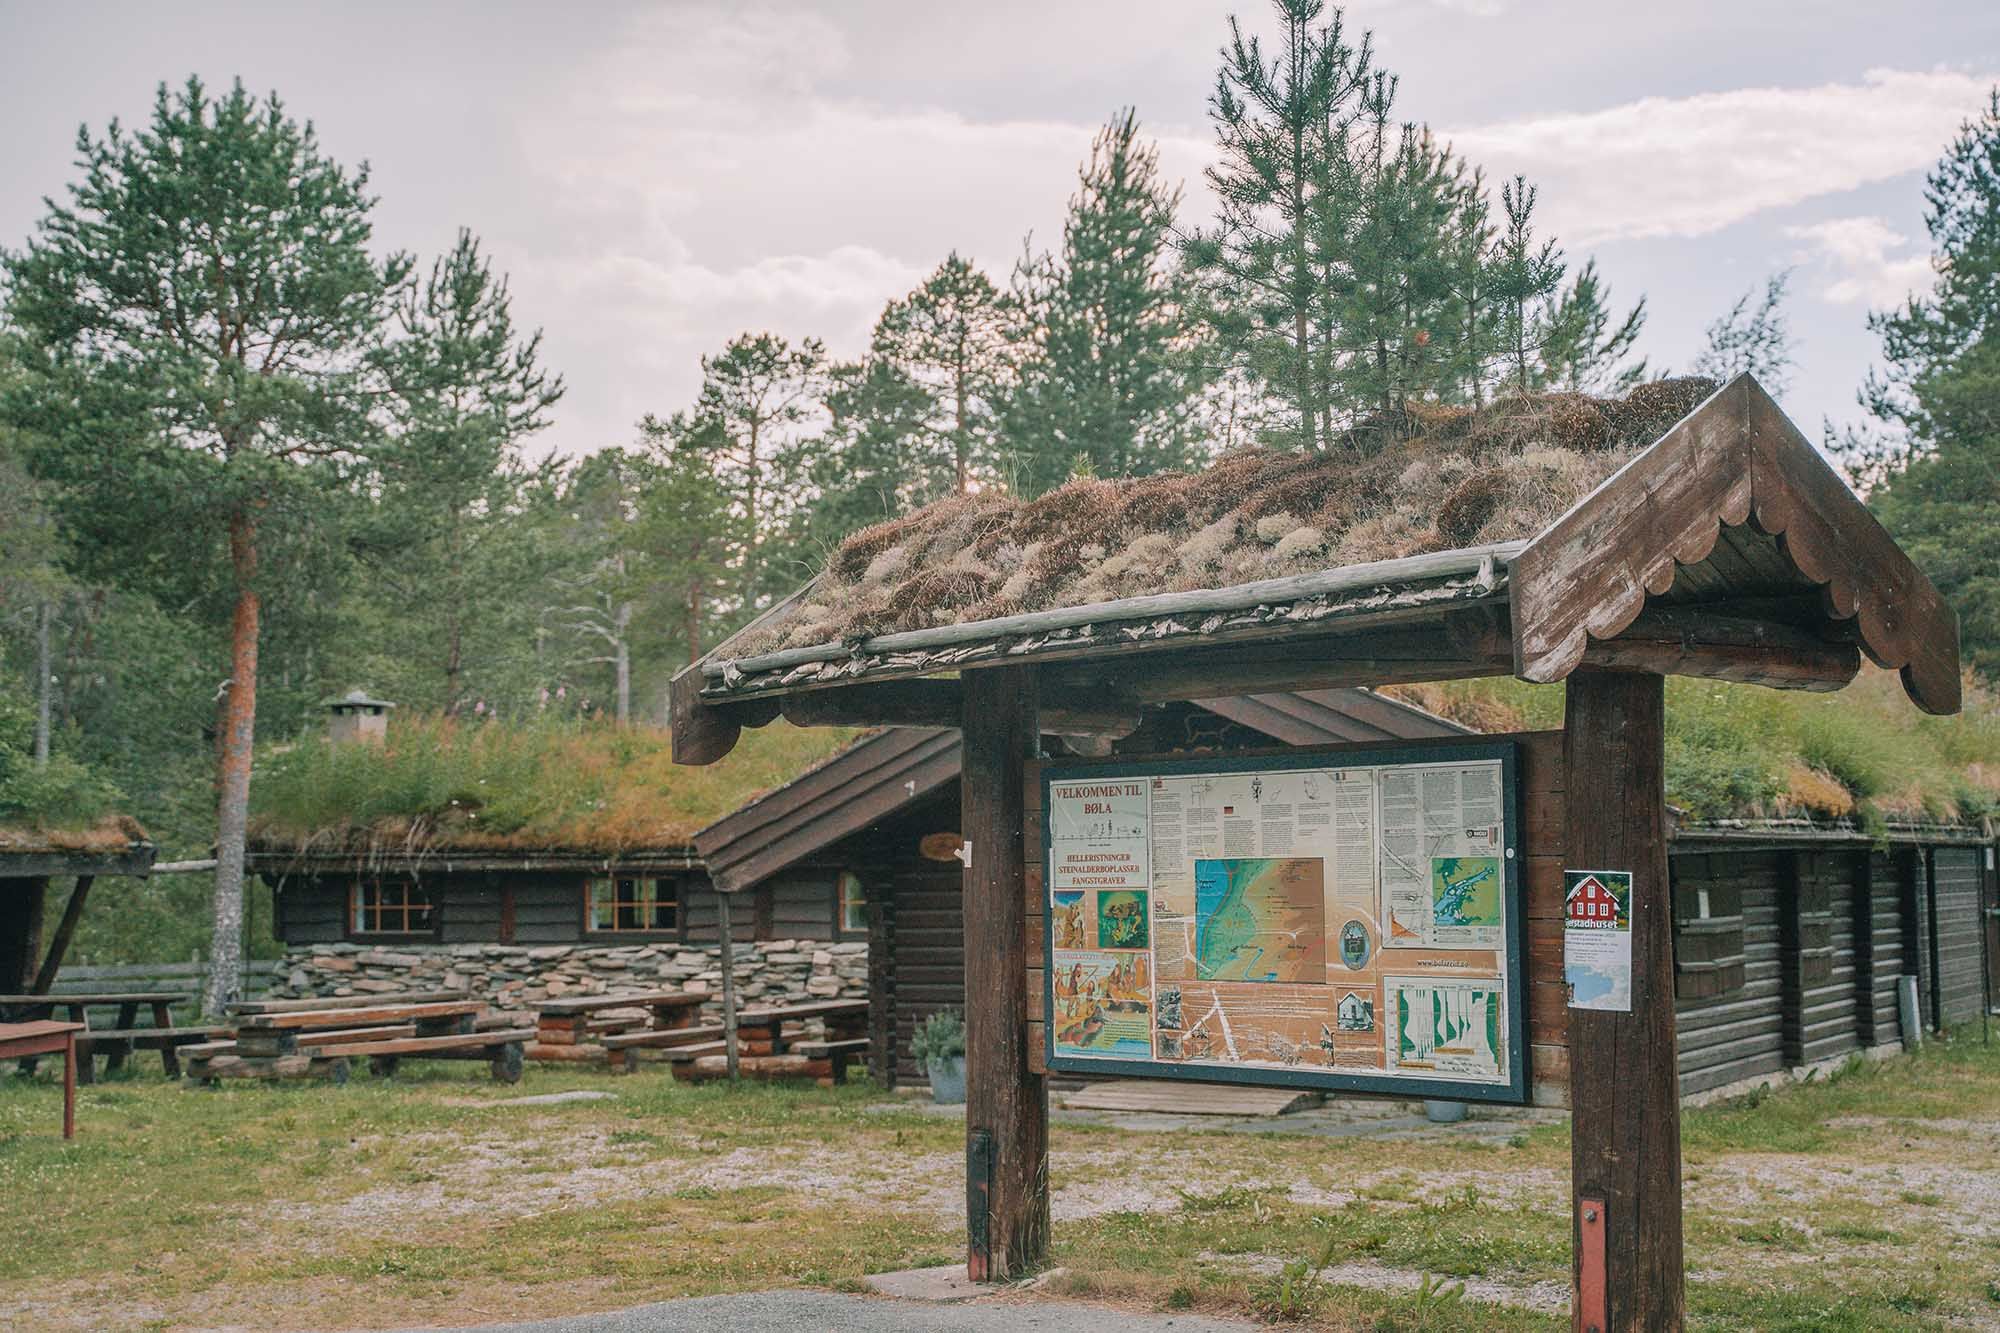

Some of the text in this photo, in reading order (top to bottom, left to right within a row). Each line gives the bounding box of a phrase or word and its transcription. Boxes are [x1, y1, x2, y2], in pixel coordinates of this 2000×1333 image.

[1056, 784, 1142, 799] VELKOMMEN TIL
[1084, 803, 1112, 814] BØLA
[1067, 854, 1131, 862] HELLERISTNINGER
[1072, 877, 1126, 885] FANGSTGRAVER
